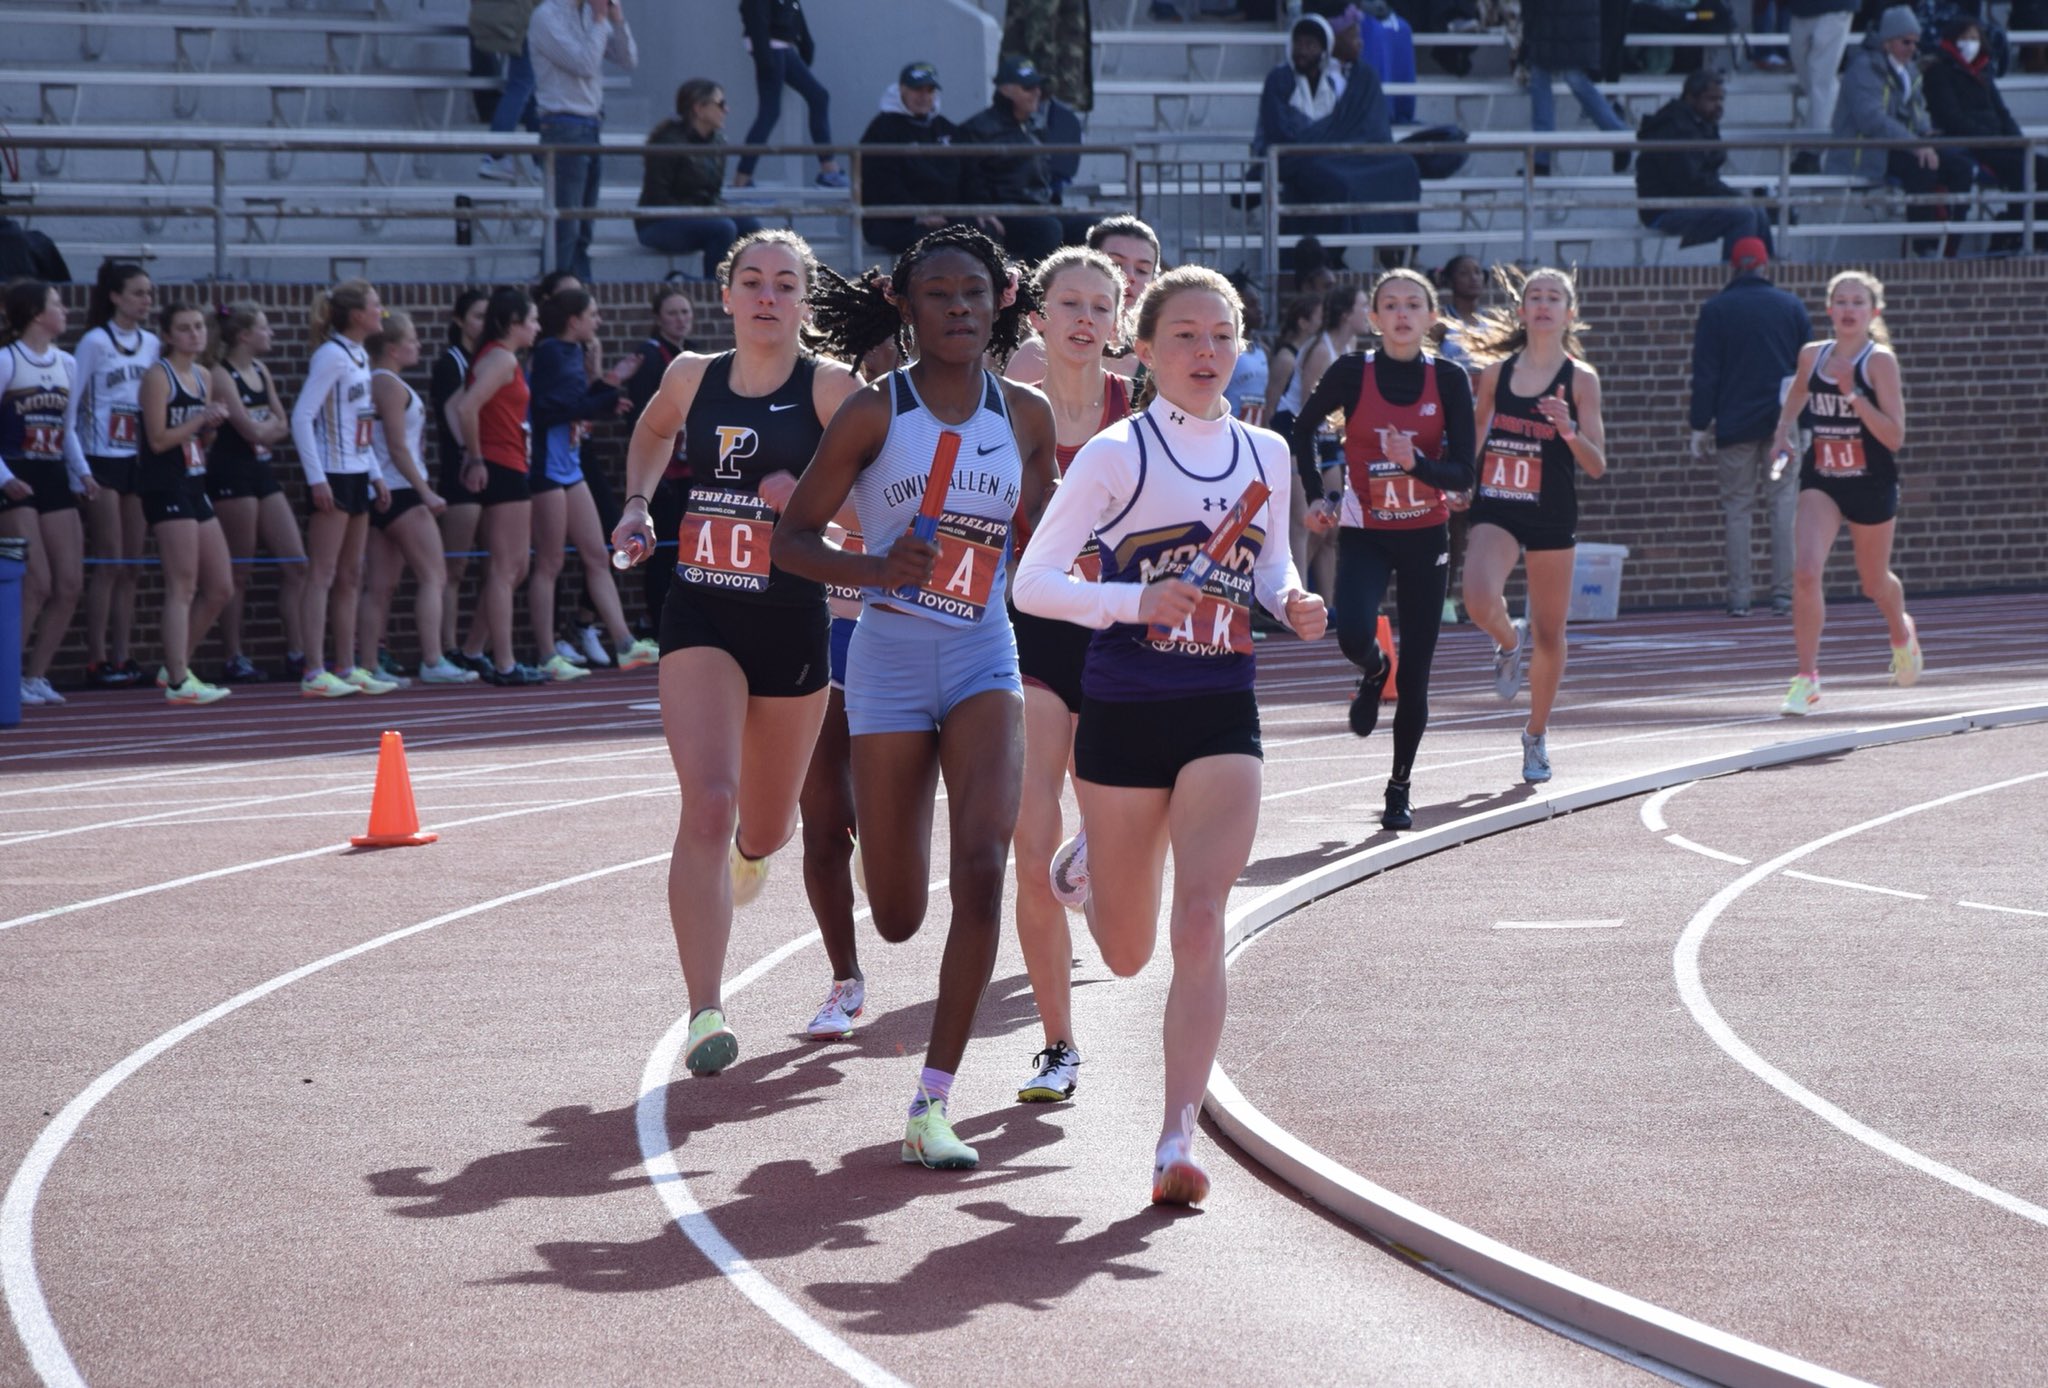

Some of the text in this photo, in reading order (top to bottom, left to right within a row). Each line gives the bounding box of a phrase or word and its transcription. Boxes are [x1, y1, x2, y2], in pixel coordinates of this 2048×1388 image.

[1809, 392, 1860, 418] AVE
[714, 425, 759, 480] P
[1824, 443, 1854, 467] A J
[1492, 457, 1506, 486] A
[690, 490, 772, 509] PENN RELAY
[1384, 479, 1426, 509] A L
[955, 515, 1008, 536] RELAYS
[695, 520, 753, 569] A C
[705, 572, 760, 590] TOYOTA
[945, 547, 974, 597] A
[1209, 569, 1252, 592] RELAYS
[917, 591, 974, 619] TOYOTA
[1168, 604, 1234, 650] A K
